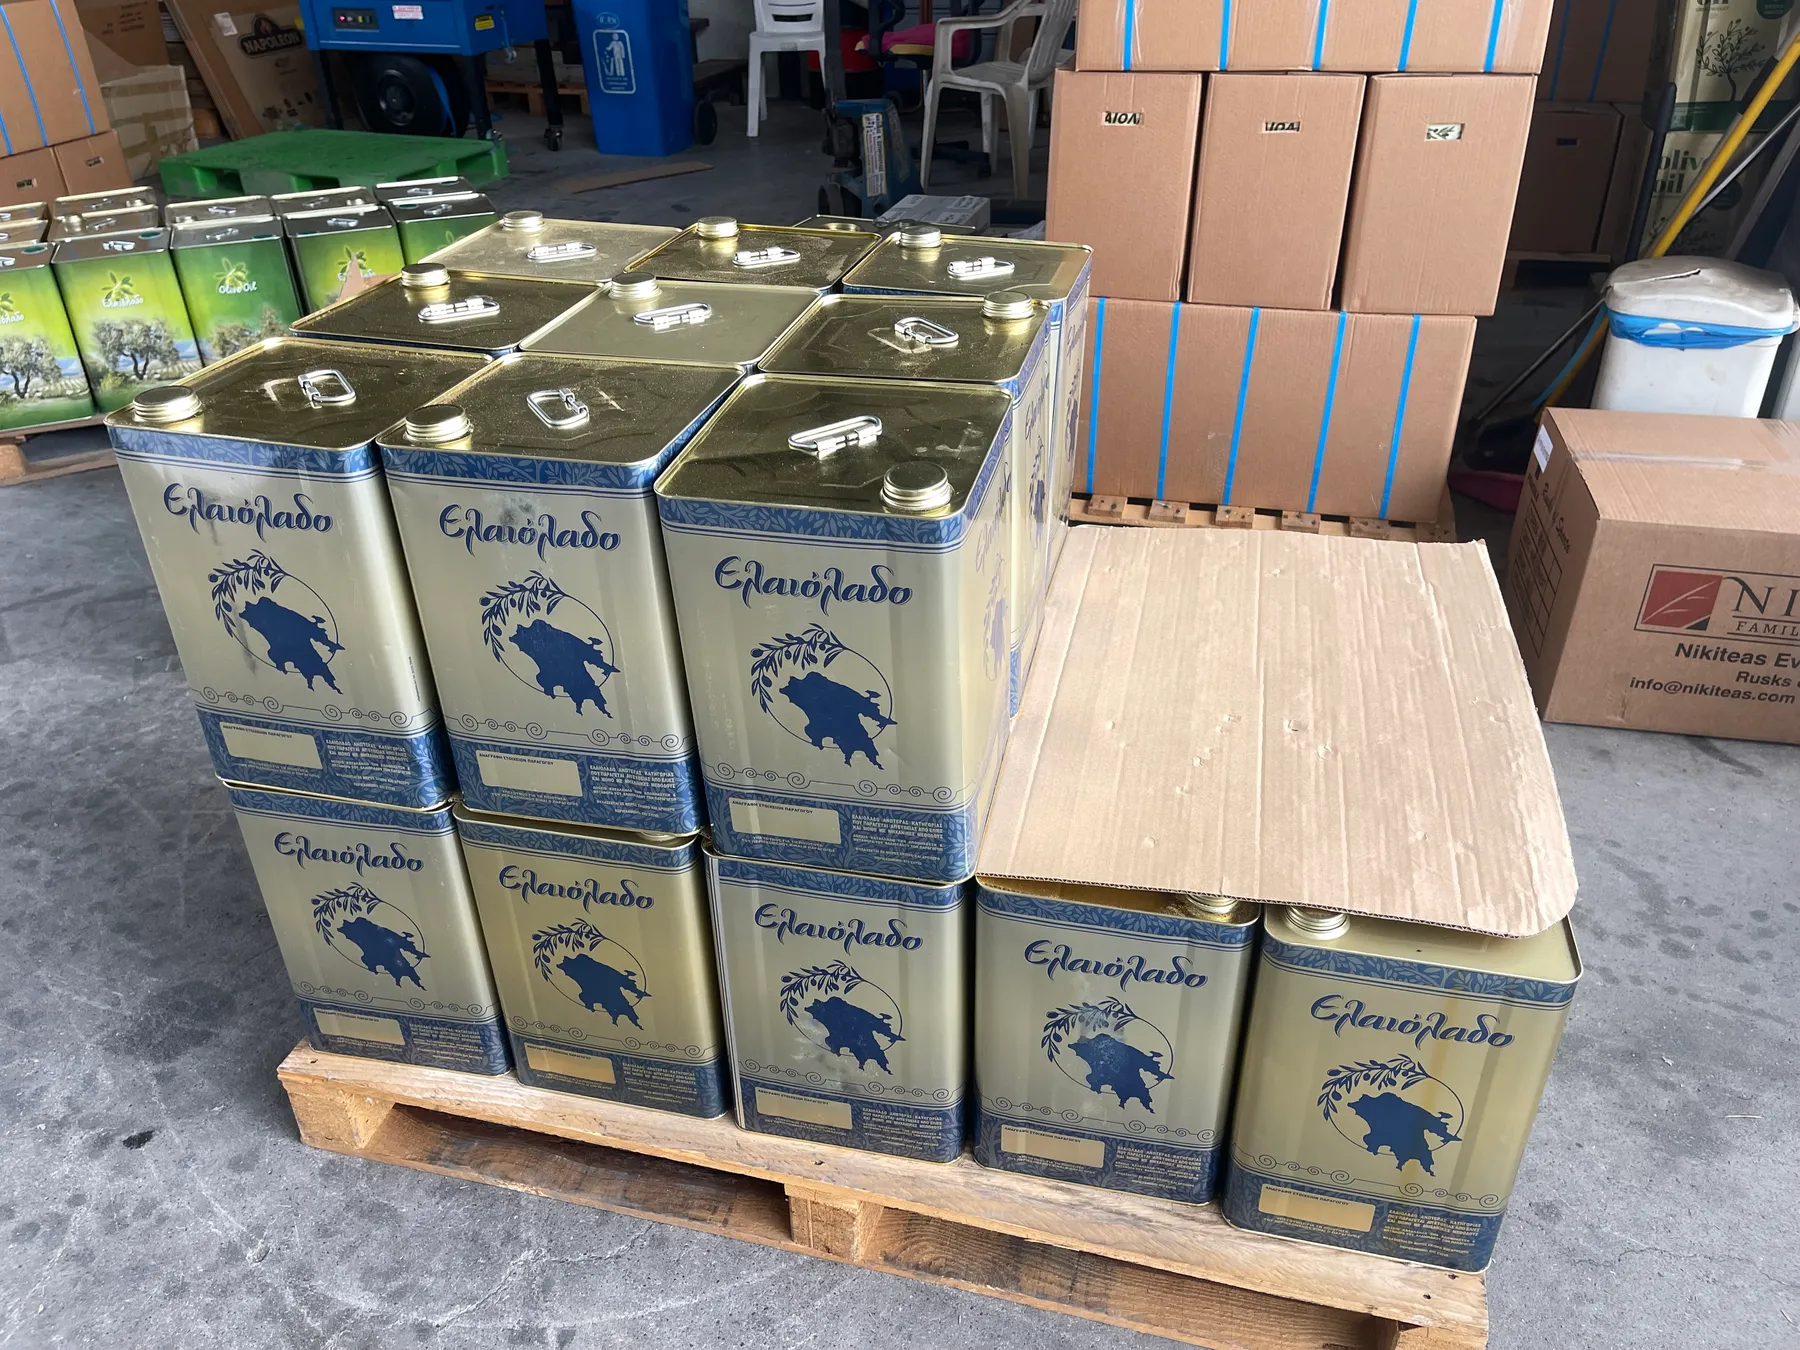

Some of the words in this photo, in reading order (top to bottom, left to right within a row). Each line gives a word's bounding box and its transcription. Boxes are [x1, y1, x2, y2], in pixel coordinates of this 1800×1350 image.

[244, 32, 299, 54] NAPOLEON
[219, 284, 242, 294] Olive
[243, 281, 257, 292] Oil
[164, 483, 333, 543] Ελαιόλαδο
[439, 504, 621, 563] Ελαιόλαδο
[714, 556, 912, 616] Ελαιόλαδο
[1675, 642, 1767, 666] Nikiteas
[1629, 677, 1796, 704] info@nikiteas.com
[1735, 670, 1792, 688] Rusks
[274, 832, 424, 878] Ελαιόλαδο
[499, 865, 654, 914] Ελαιόλαδο
[754, 903, 923, 956] Ελαιόλαδο
[1024, 940, 1208, 993] Ελαιόλαδο
[1310, 994, 1515, 1050] Ελαιόλαδο
